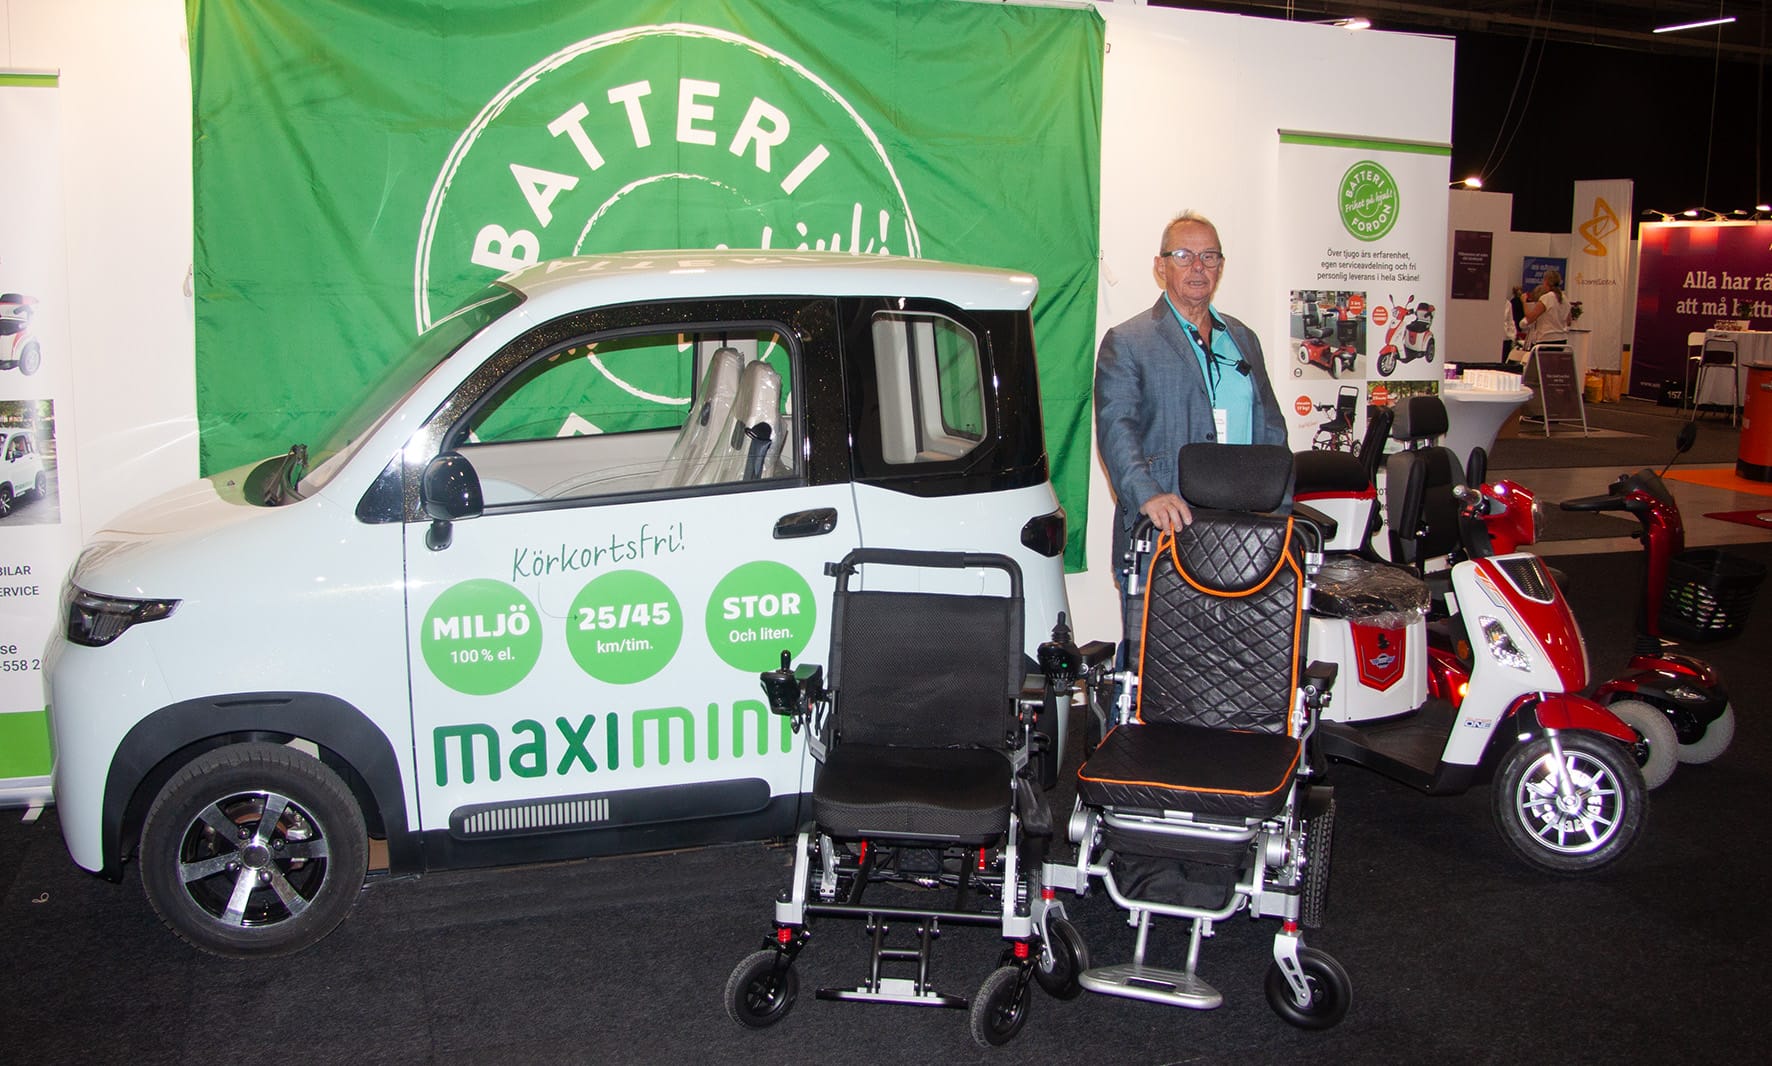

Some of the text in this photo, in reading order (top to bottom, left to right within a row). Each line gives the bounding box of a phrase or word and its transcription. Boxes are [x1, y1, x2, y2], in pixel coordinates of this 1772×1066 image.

[471, 79, 830, 273] BATTERI
[1345, 171, 1385, 198] BATTERI
[1351, 204, 1392, 232] FORDON
[1343, 250, 1360, 260] tjugo
[1320, 260, 1417, 271] egen serviceavdelning och fri
[1317, 272, 1348, 282] personlig
[1348, 272, 1376, 281] leverans
[1381, 273, 1396, 281] hela
[1683, 271, 1717, 289] Alla
[1720, 271, 1752, 290] har
[1676, 298, 1698, 315] att
[1701, 296, 1728, 316] må
[1666, 390, 1682, 400] 157
[512, 522, 685, 582] Körkortsfri!
[723, 592, 801, 620] STOR
[433, 604, 530, 640] MILJÖ
[579, 602, 671, 630] 25/45
[729, 627, 794, 643] Och liten.
[497, 646, 515, 661] el.
[597, 637, 653, 654] km/tim.
